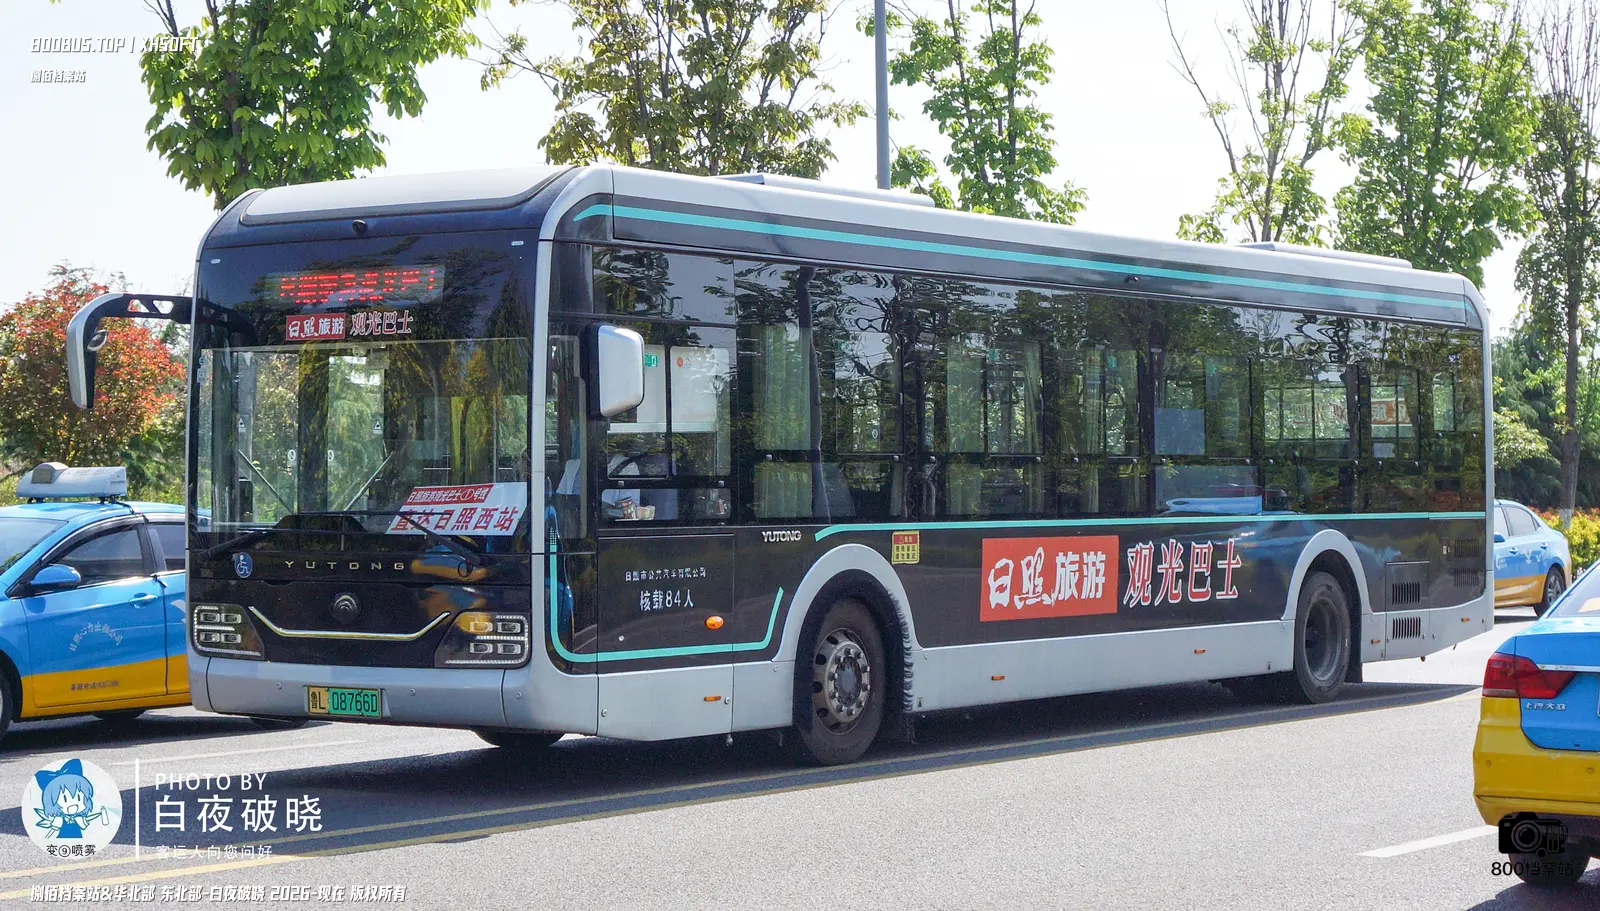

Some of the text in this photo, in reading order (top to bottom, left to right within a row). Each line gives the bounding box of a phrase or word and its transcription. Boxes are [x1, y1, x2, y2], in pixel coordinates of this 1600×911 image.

[287, 310, 413, 338] 日照旅游 观光巴士
[391, 505, 519, 533] 直达日照西站
[761, 530, 802, 543] YUTONG
[284, 560, 406, 571] YUTONG
[625, 567, 706, 582] 日照市公共汽车有限公司
[987, 538, 1242, 610] 日照旅游 观光巴士
